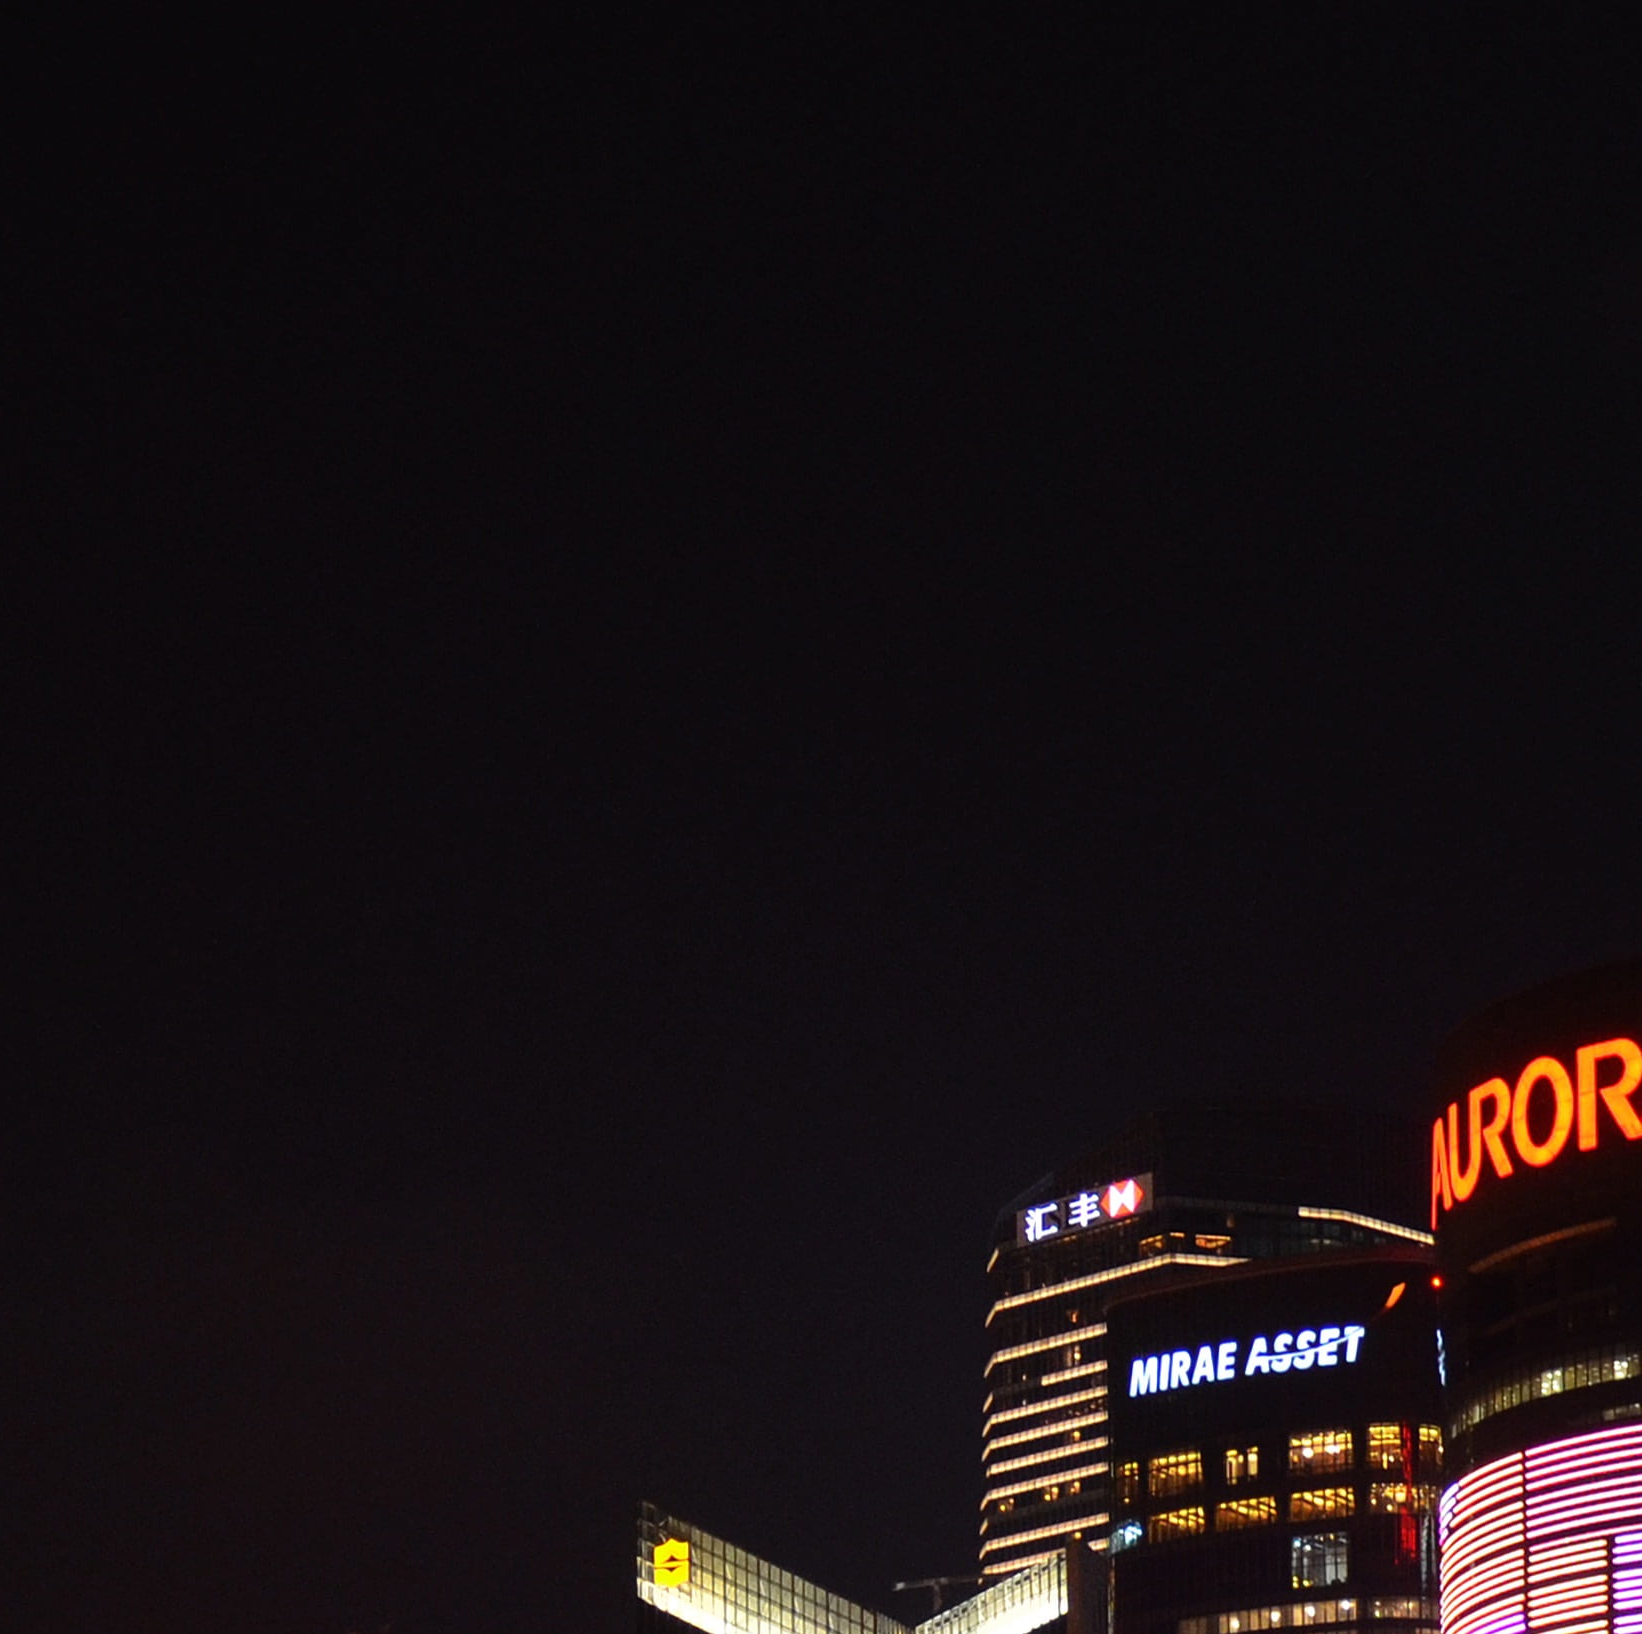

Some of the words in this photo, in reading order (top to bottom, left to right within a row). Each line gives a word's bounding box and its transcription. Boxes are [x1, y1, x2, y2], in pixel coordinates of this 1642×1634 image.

[1024, 1192, 1101, 1242] 汇丰
[1129, 1342, 1237, 1397] MIRAE
[1245, 1326, 1365, 1376] ASSET
